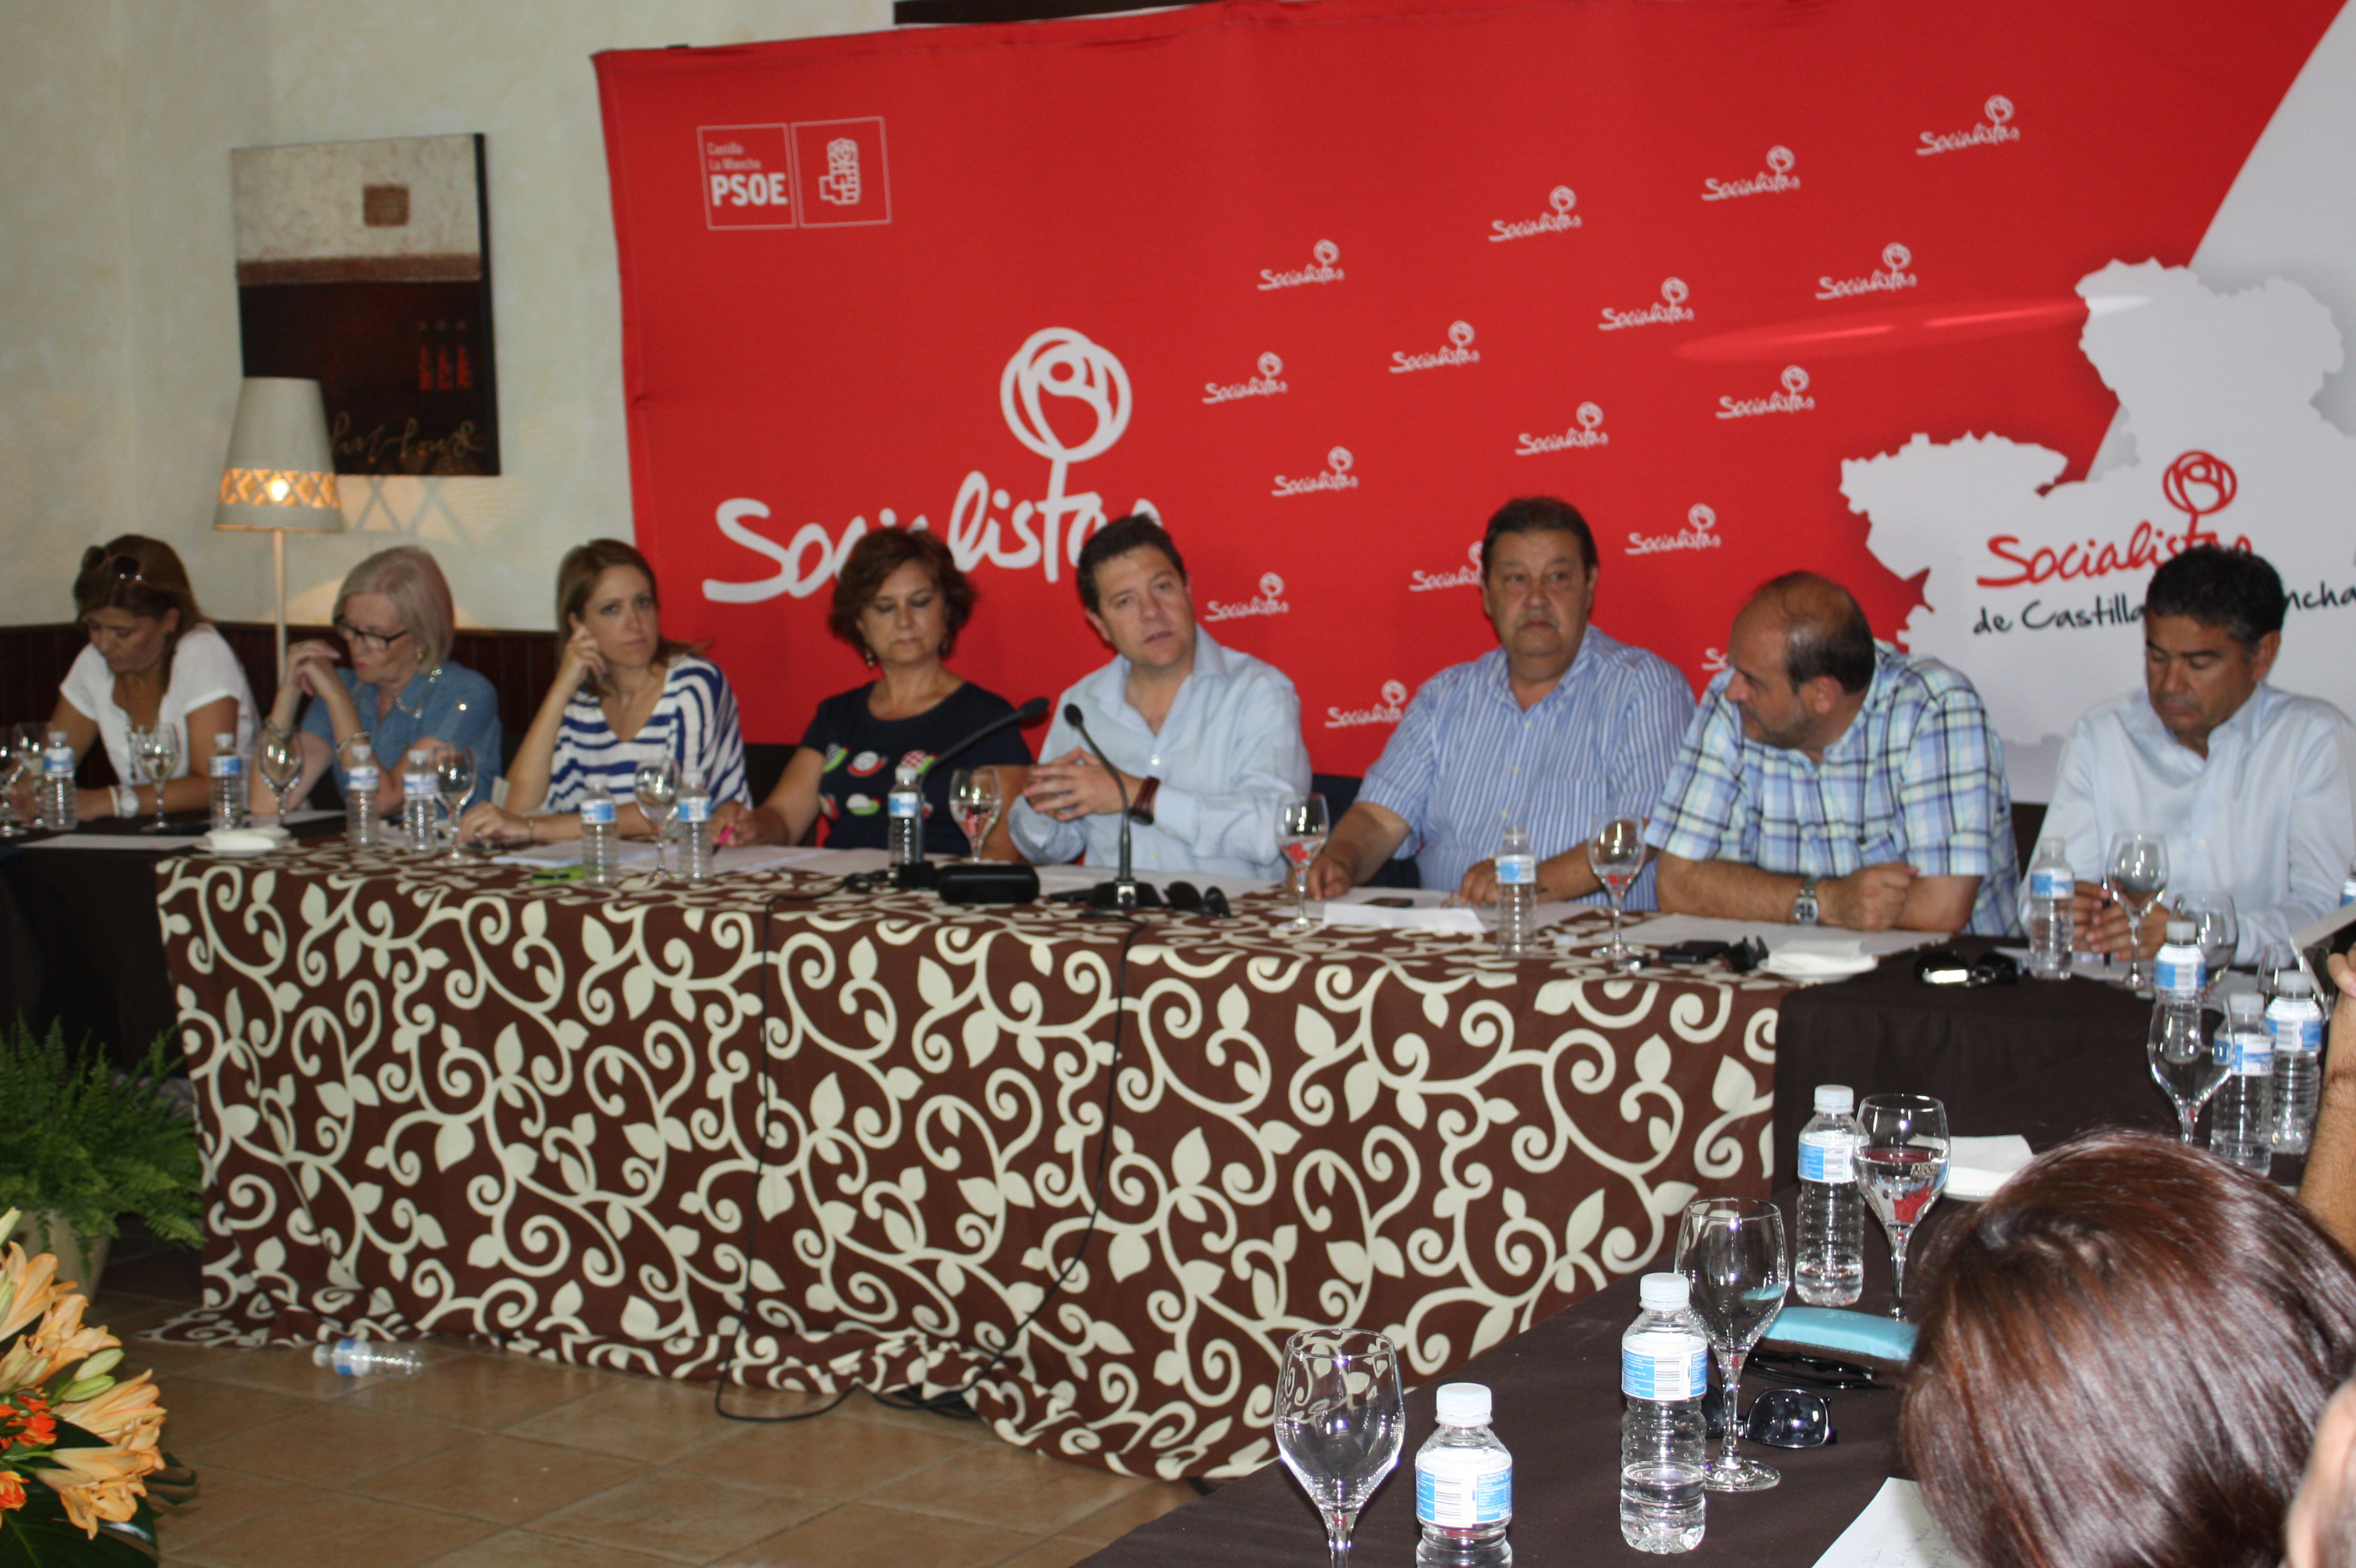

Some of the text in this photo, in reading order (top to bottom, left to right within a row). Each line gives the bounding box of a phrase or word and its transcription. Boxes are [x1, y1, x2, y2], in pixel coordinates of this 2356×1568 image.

[1916, 121, 2020, 155] Socialistas
[710, 172, 788, 208] PSOE
[1702, 169, 1800, 201] Socialistas
[1488, 209, 1582, 242] Socialistas
[1257, 262, 1344, 290] Socialistas
[1815, 267, 1917, 299] Socialistas
[1598, 300, 1694, 330] Socialistas
[1389, 344, 1480, 373] Socialistas
[1202, 374, 1287, 404] Socialistas
[1715, 389, 1815, 419] Socialistas
[1515, 425, 1608, 455] Socialistas
[1271, 469, 1358, 496] Socialistas
[1625, 528, 1721, 555] Socialistas
[1204, 594, 1290, 621] Socialistas
[1974, 606, 2012, 635] de
